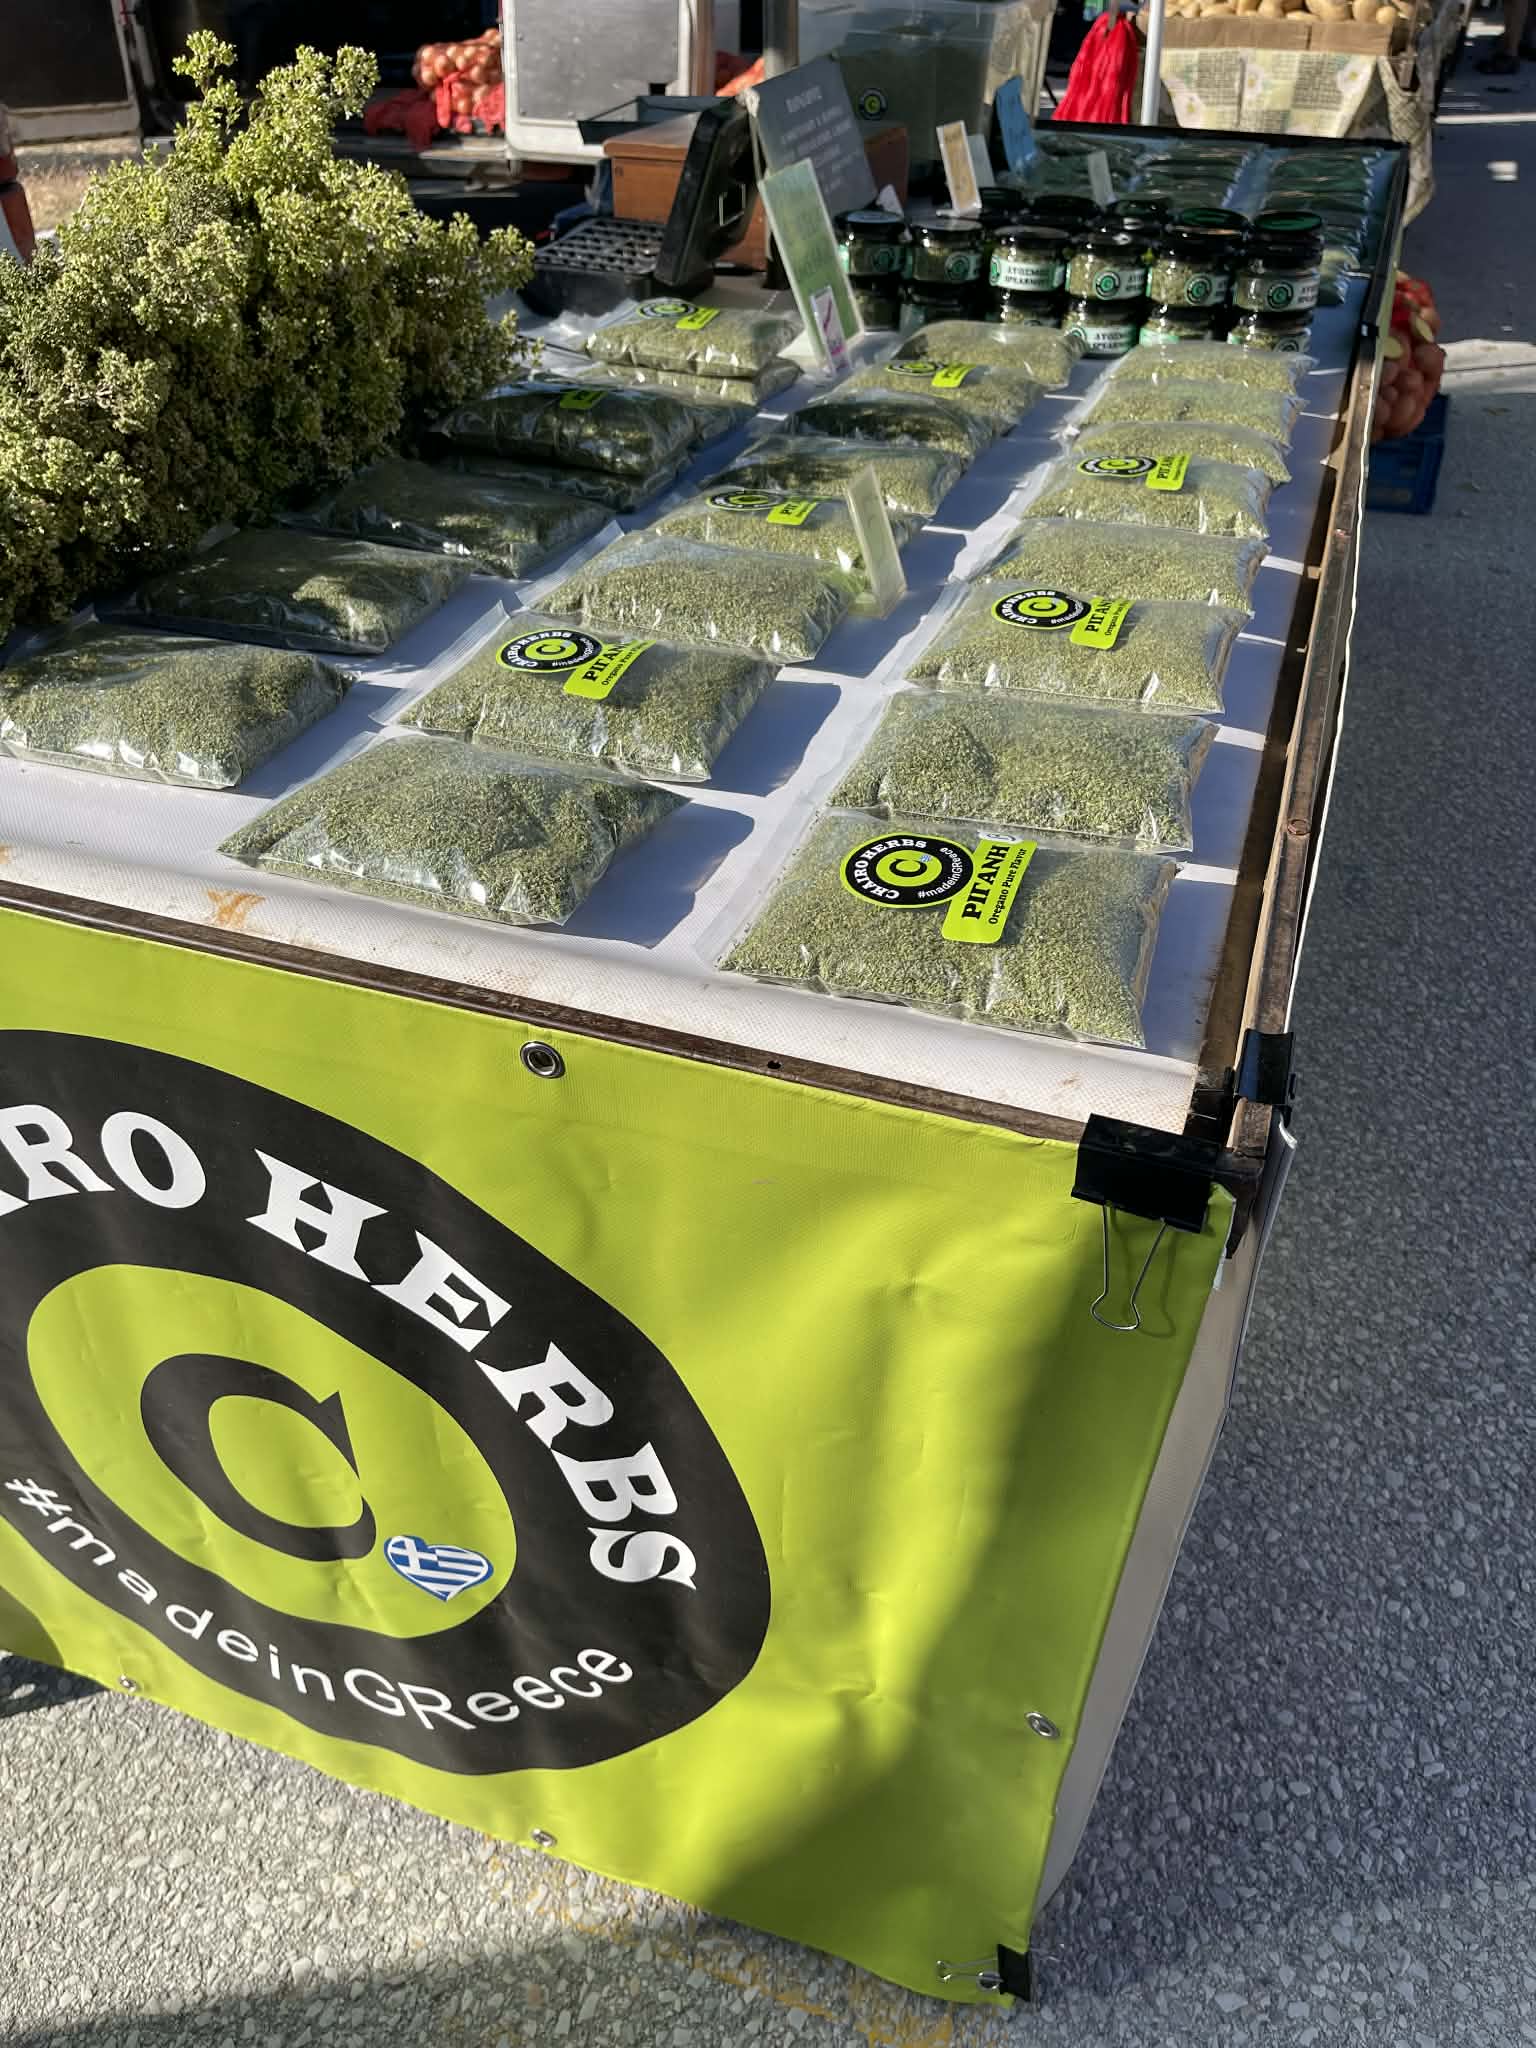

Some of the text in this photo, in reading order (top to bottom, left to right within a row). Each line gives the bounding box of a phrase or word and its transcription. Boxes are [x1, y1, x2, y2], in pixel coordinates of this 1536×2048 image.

[854, 838, 927, 900] CHAIRO HERBS
[889, 858, 928, 878] C
[988, 848, 1028, 925] Oregano Pure Flavor
[0, 1104, 697, 1590] RO HERBS
[140, 1353, 377, 1562] C
[4, 1477, 634, 1731] #madeinGReece
